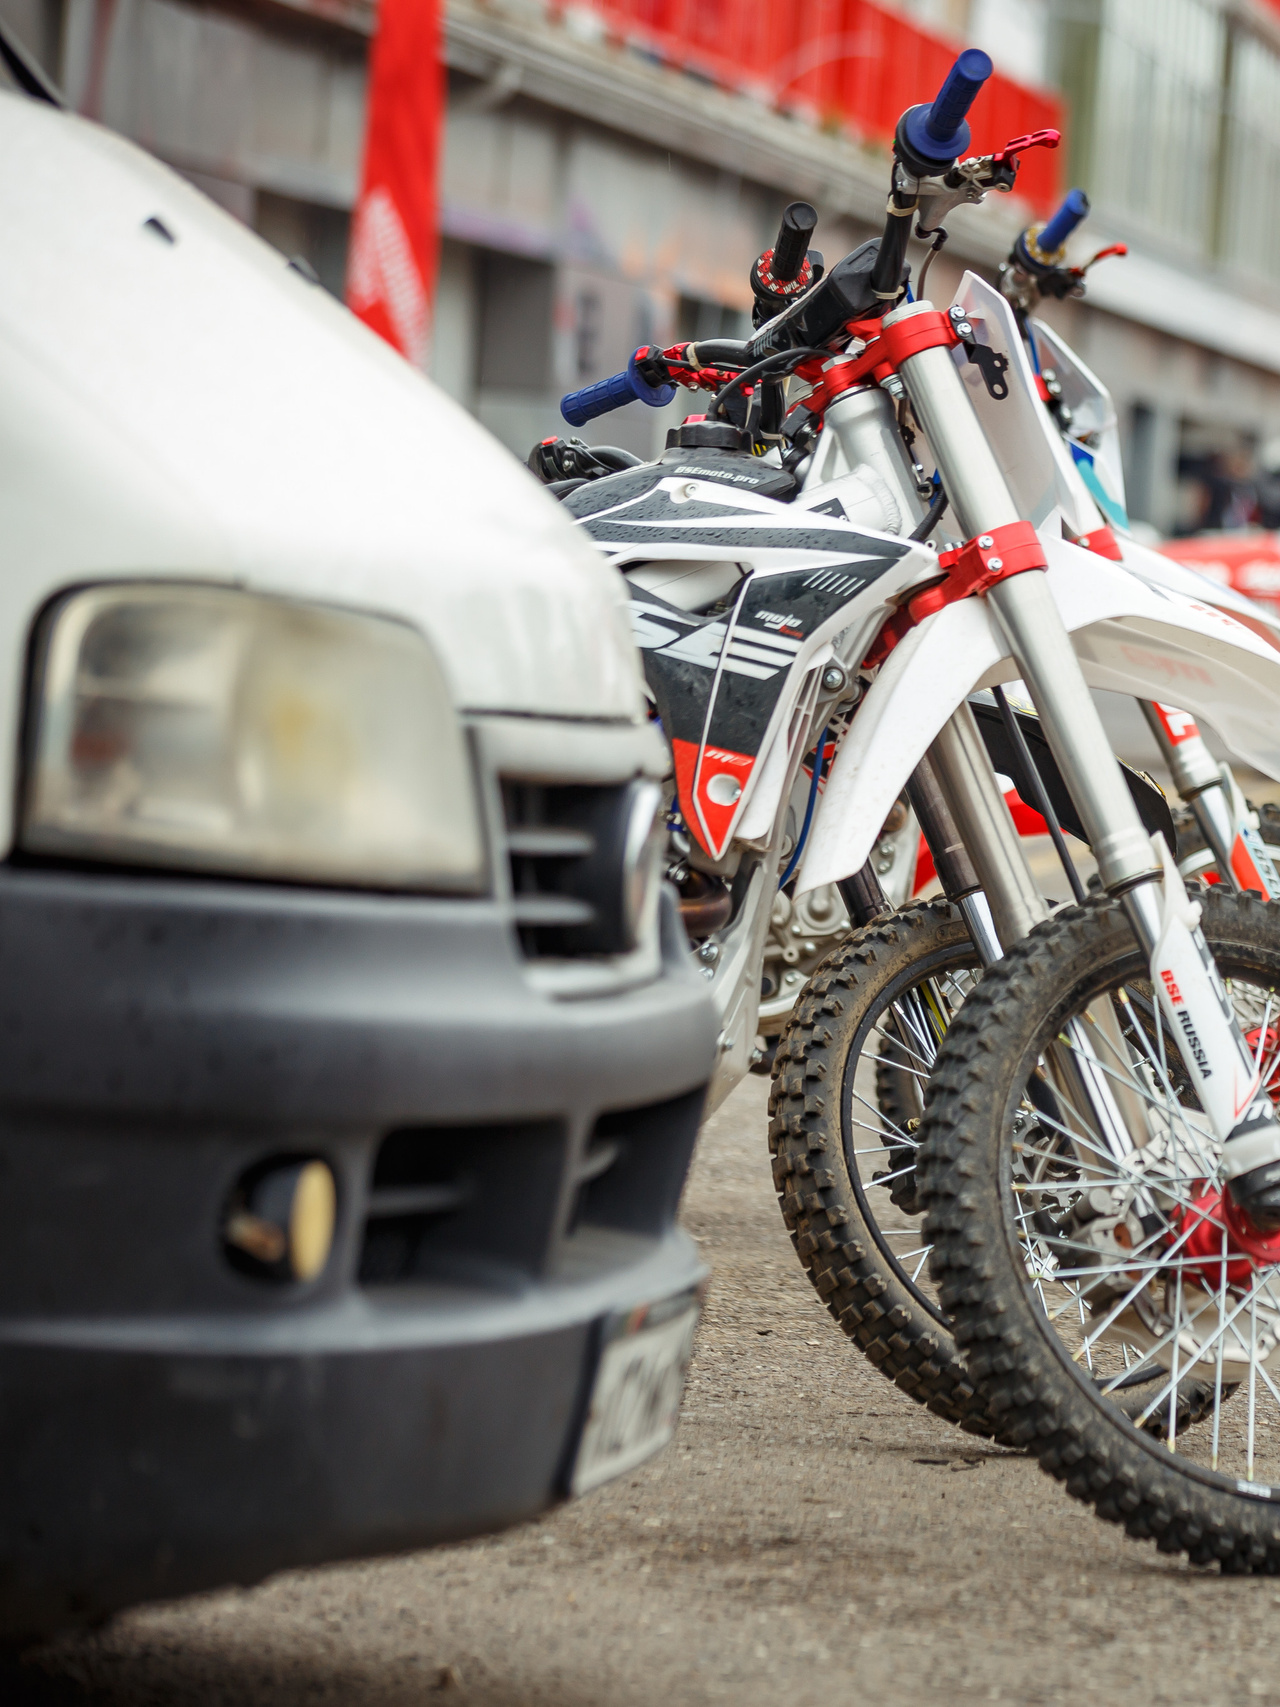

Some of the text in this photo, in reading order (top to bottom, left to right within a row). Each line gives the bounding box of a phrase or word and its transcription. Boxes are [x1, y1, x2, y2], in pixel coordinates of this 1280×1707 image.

[673, 466, 760, 485] BSEmoto.pro
[1160, 969, 1214, 1080] BSE RUSSIA
